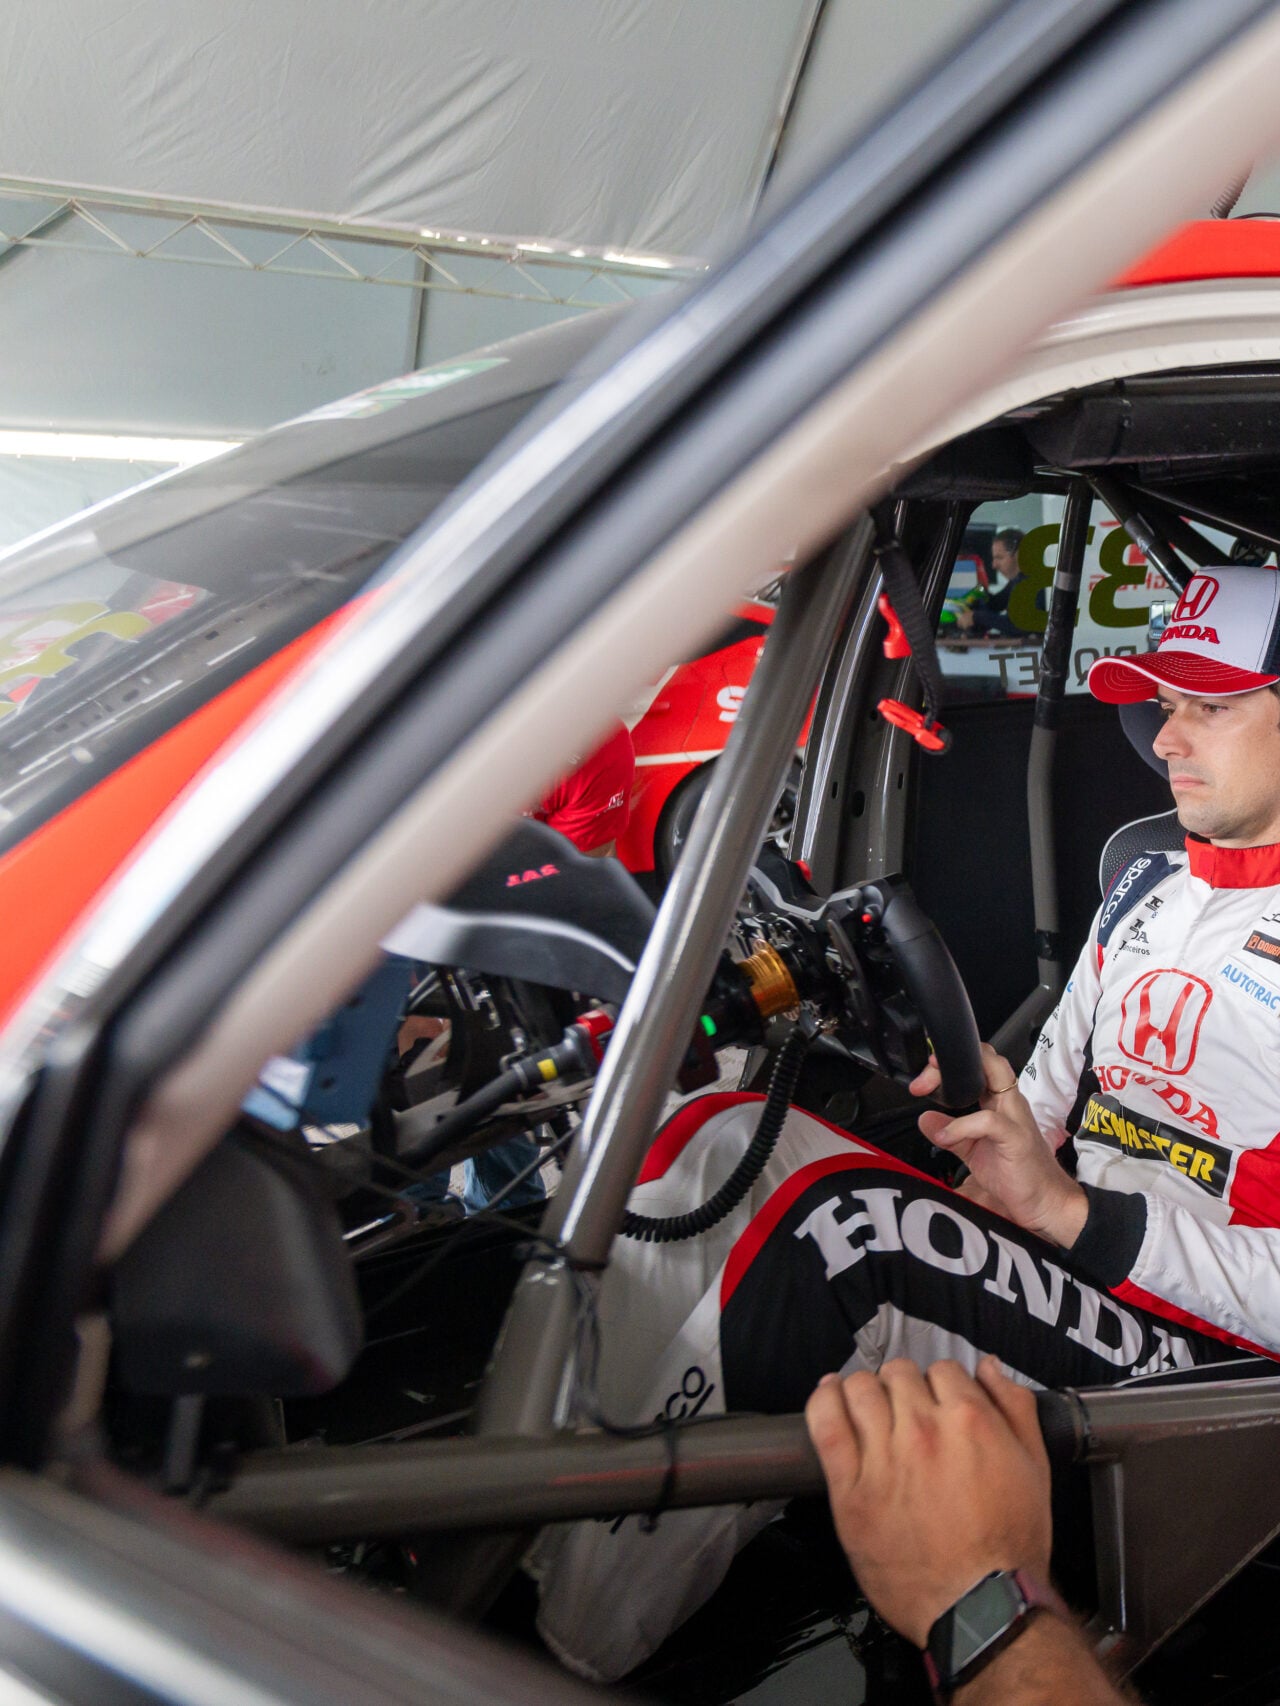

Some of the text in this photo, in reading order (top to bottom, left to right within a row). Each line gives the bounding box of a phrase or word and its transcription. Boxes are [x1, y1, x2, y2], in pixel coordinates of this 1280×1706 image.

[1158, 625, 1220, 644] ONDA
[1099, 857, 1152, 930] sparco
[793, 1187, 1196, 1377] HONDA
